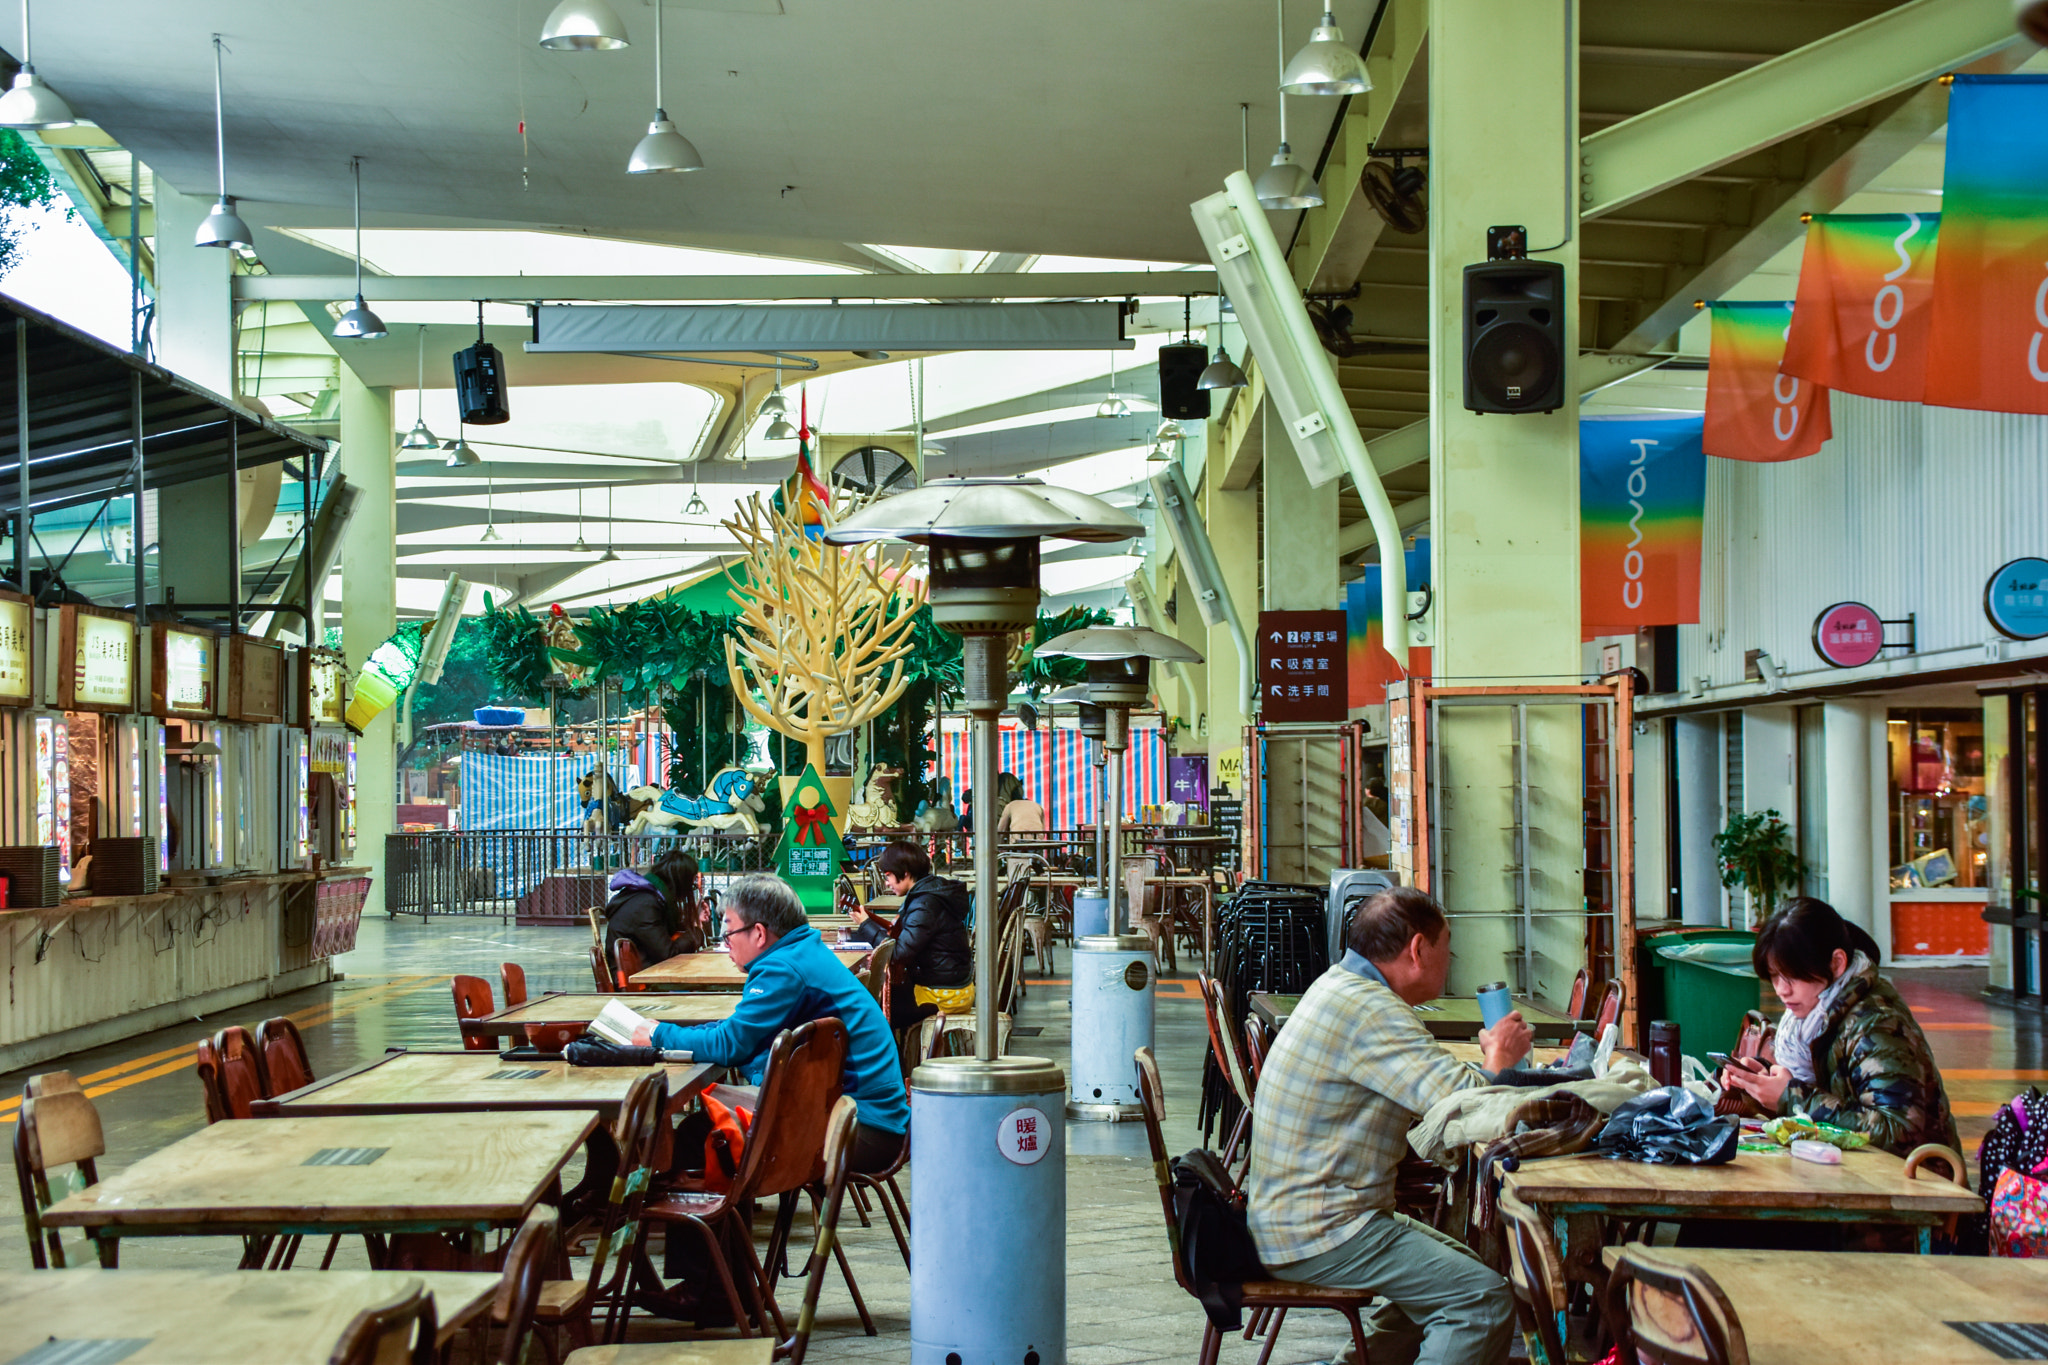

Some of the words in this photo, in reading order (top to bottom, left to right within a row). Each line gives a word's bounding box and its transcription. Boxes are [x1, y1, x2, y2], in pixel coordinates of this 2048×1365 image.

[1623, 438, 1659, 609] coway
[1287, 658, 1329, 670] 吸煙室
[1288, 685, 1329, 697] 洗手間
[1016, 1116, 1038, 1152] 暖爐
